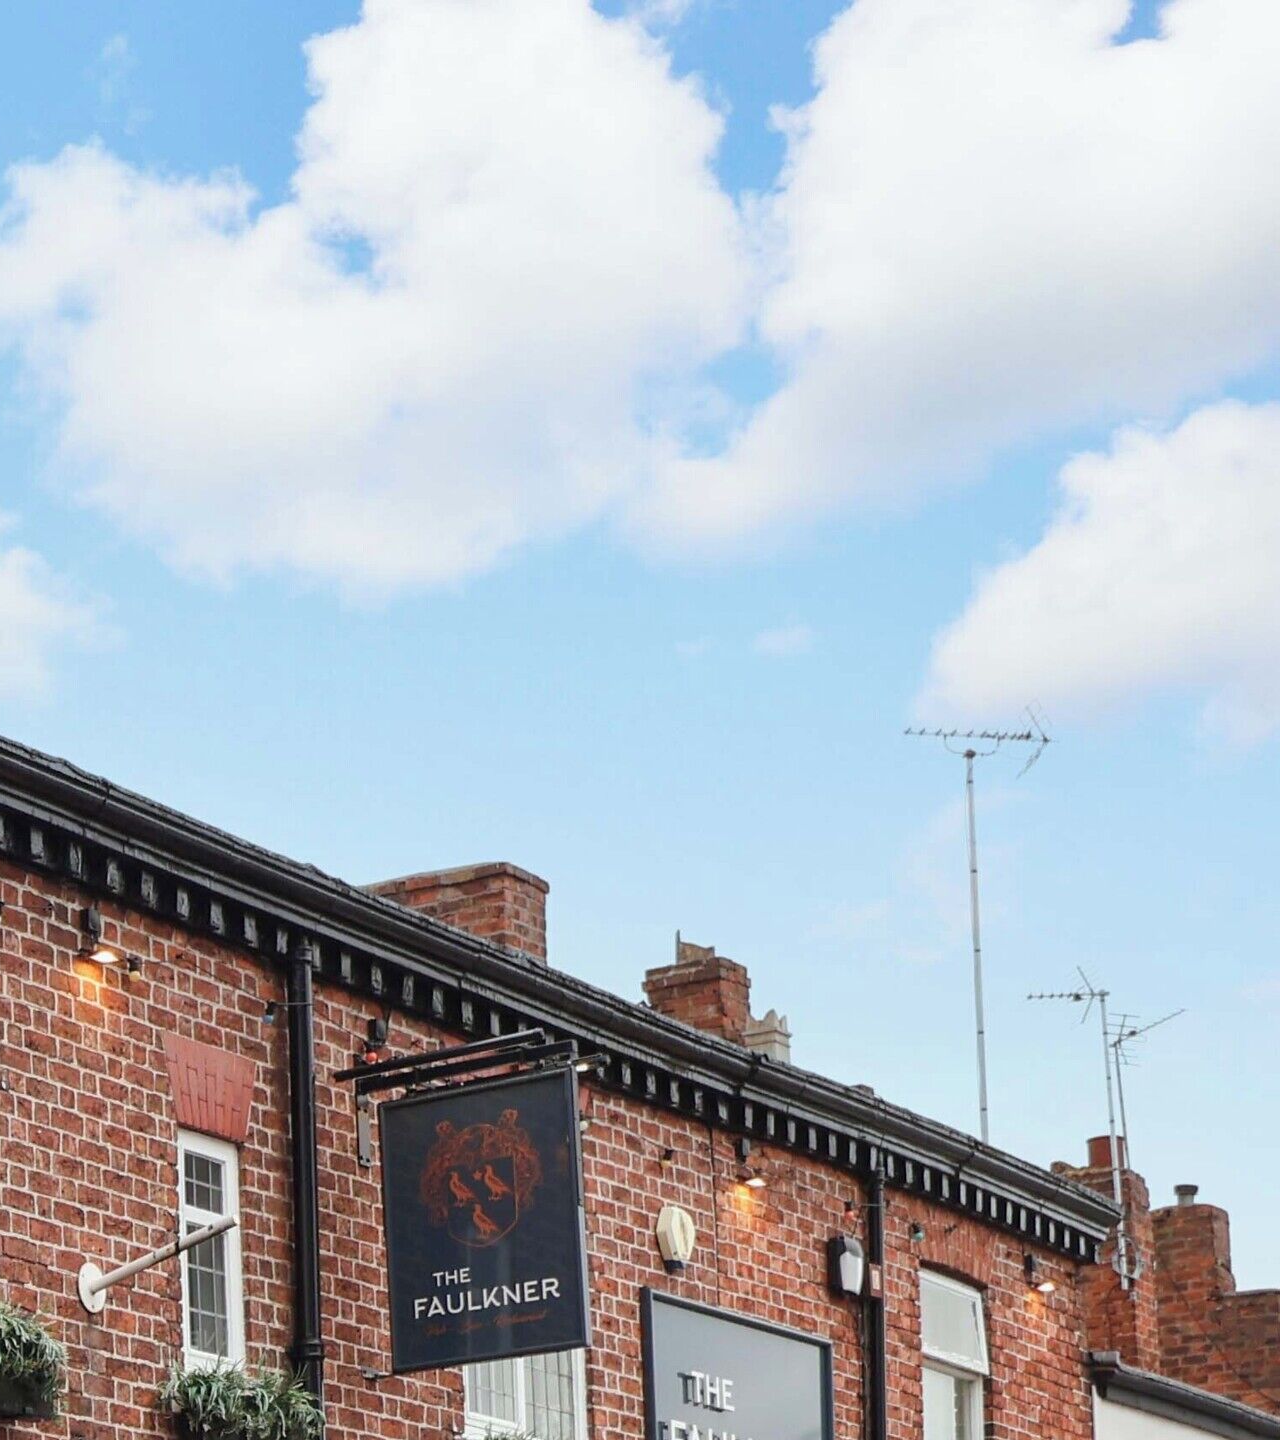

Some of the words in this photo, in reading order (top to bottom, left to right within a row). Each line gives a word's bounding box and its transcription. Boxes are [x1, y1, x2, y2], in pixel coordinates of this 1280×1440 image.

[414, 1278, 561, 1320] FAULKNER
[432, 1268, 471, 1288] THE
[691, 1370, 735, 1412] THE
